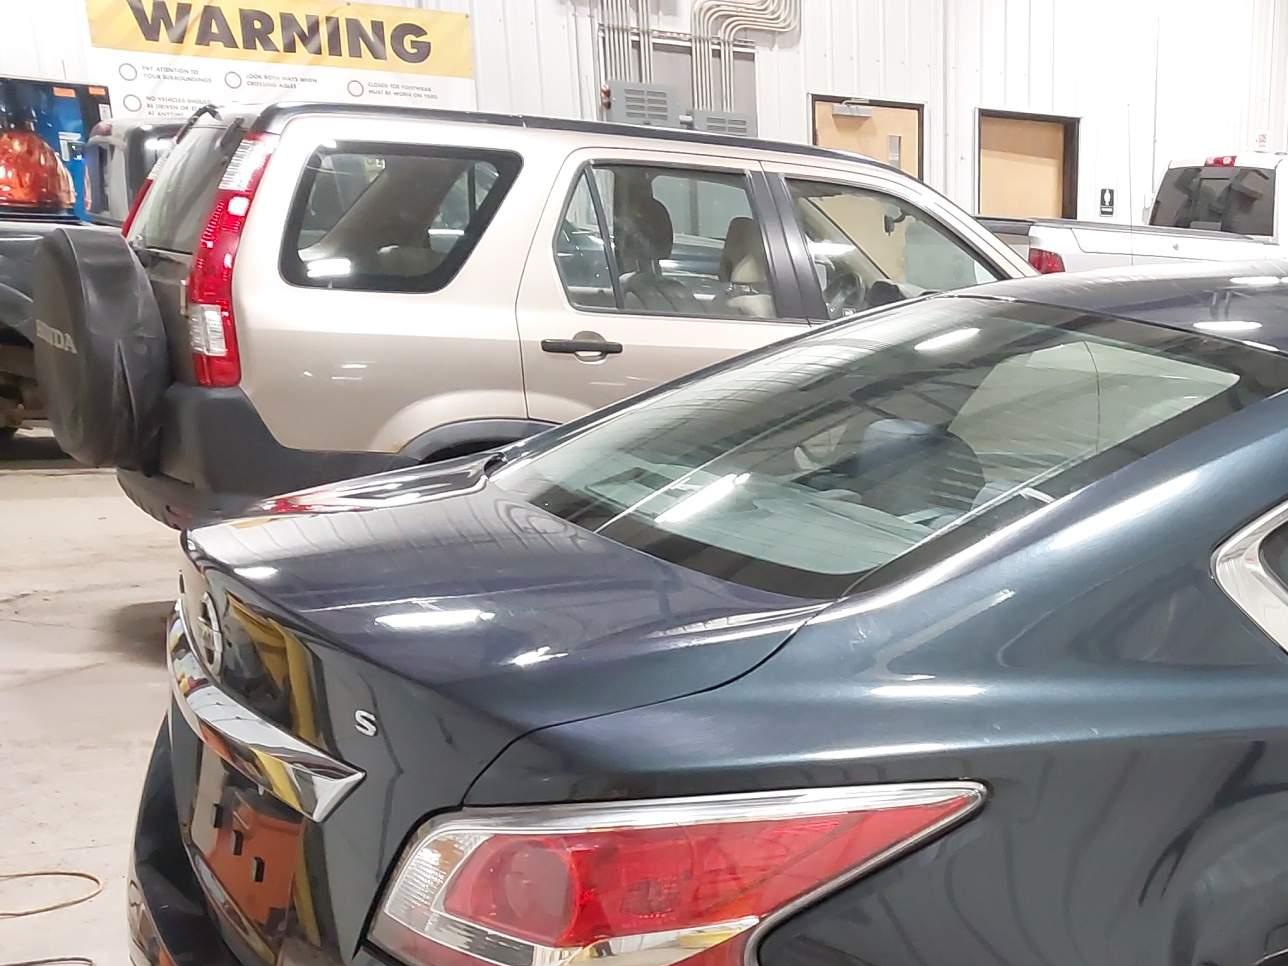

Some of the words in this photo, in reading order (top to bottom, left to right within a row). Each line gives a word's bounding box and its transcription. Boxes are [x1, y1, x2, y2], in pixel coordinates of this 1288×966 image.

[127, 0, 432, 64] WARNING
[36, 319, 78, 354] NDA
[355, 709, 377, 737] S
